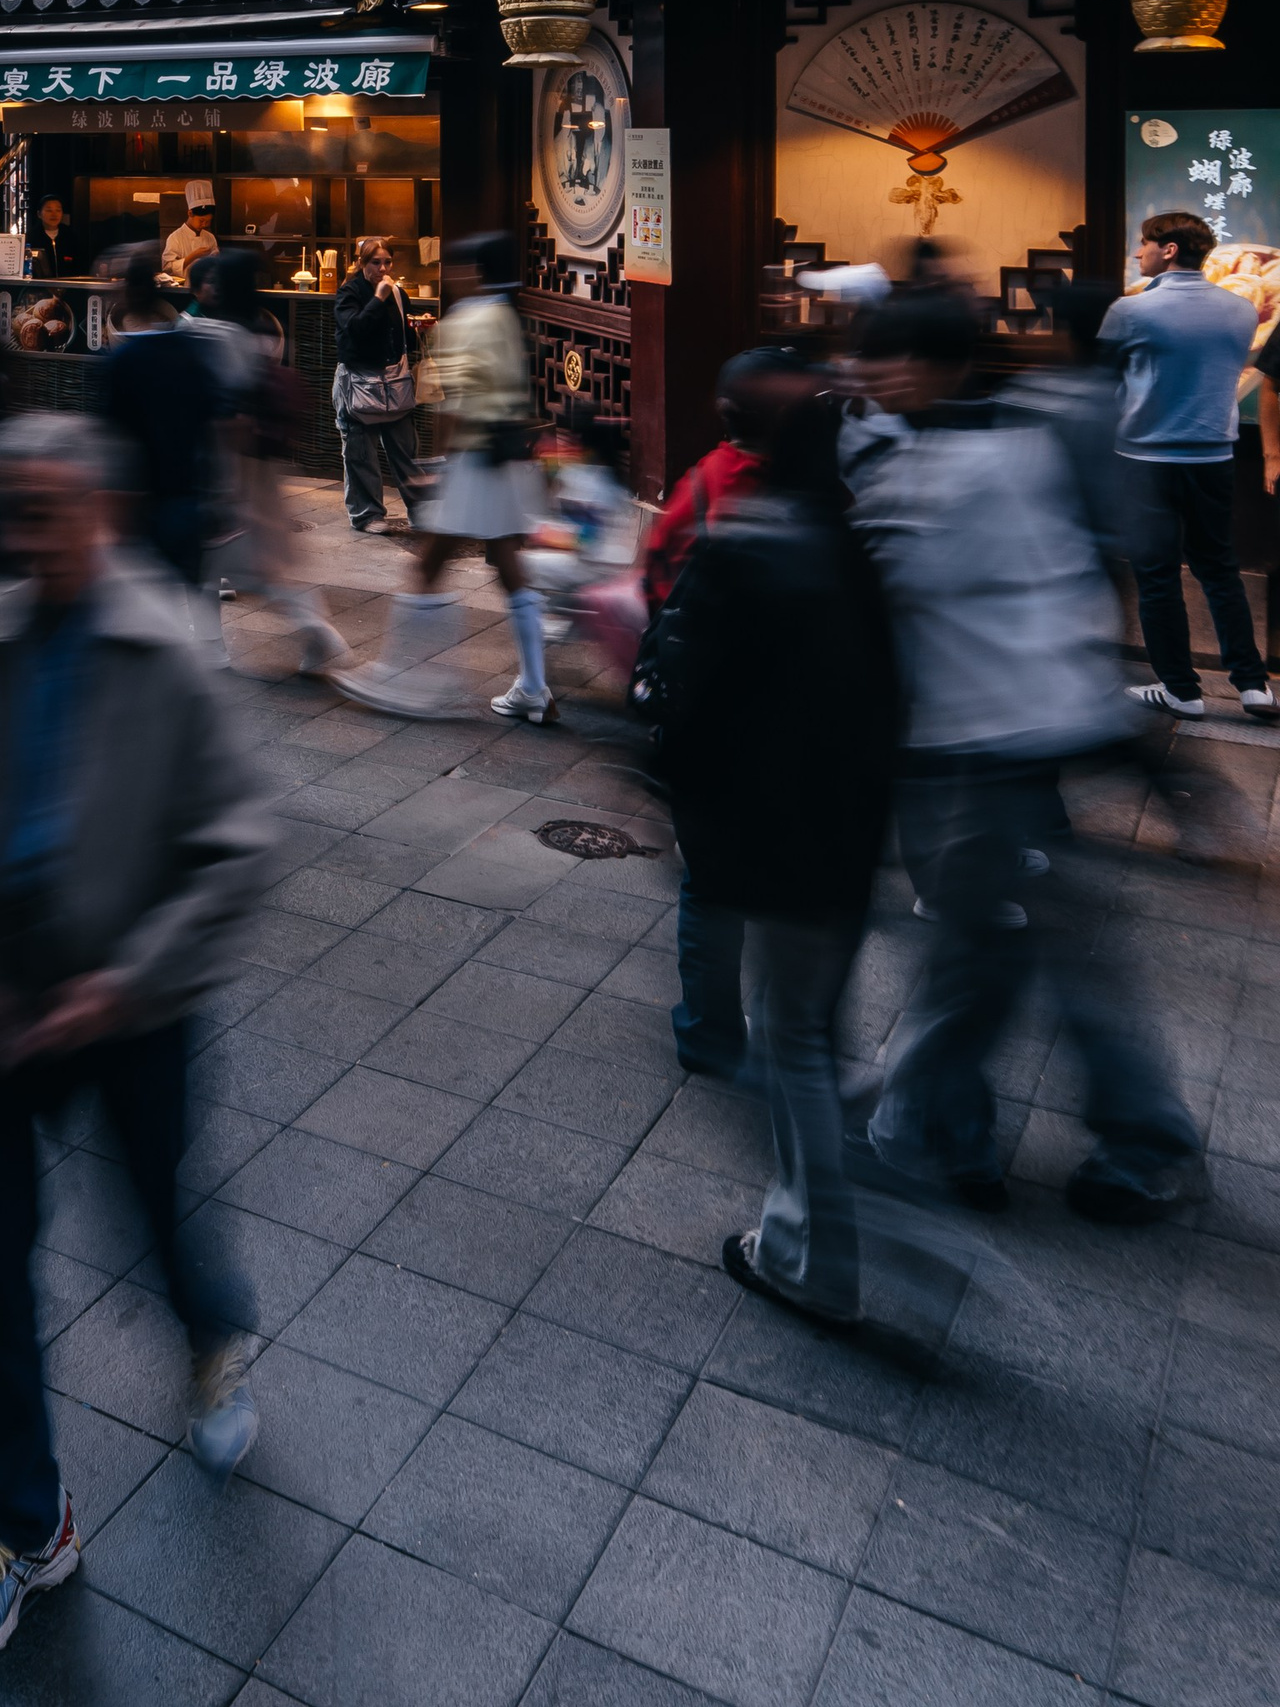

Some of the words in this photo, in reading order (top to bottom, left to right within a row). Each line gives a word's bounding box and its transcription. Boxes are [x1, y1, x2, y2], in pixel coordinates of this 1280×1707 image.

[157, 58, 395, 92] 一品绿波廊
[71, 108, 221, 129] 绿波廊点心铺
